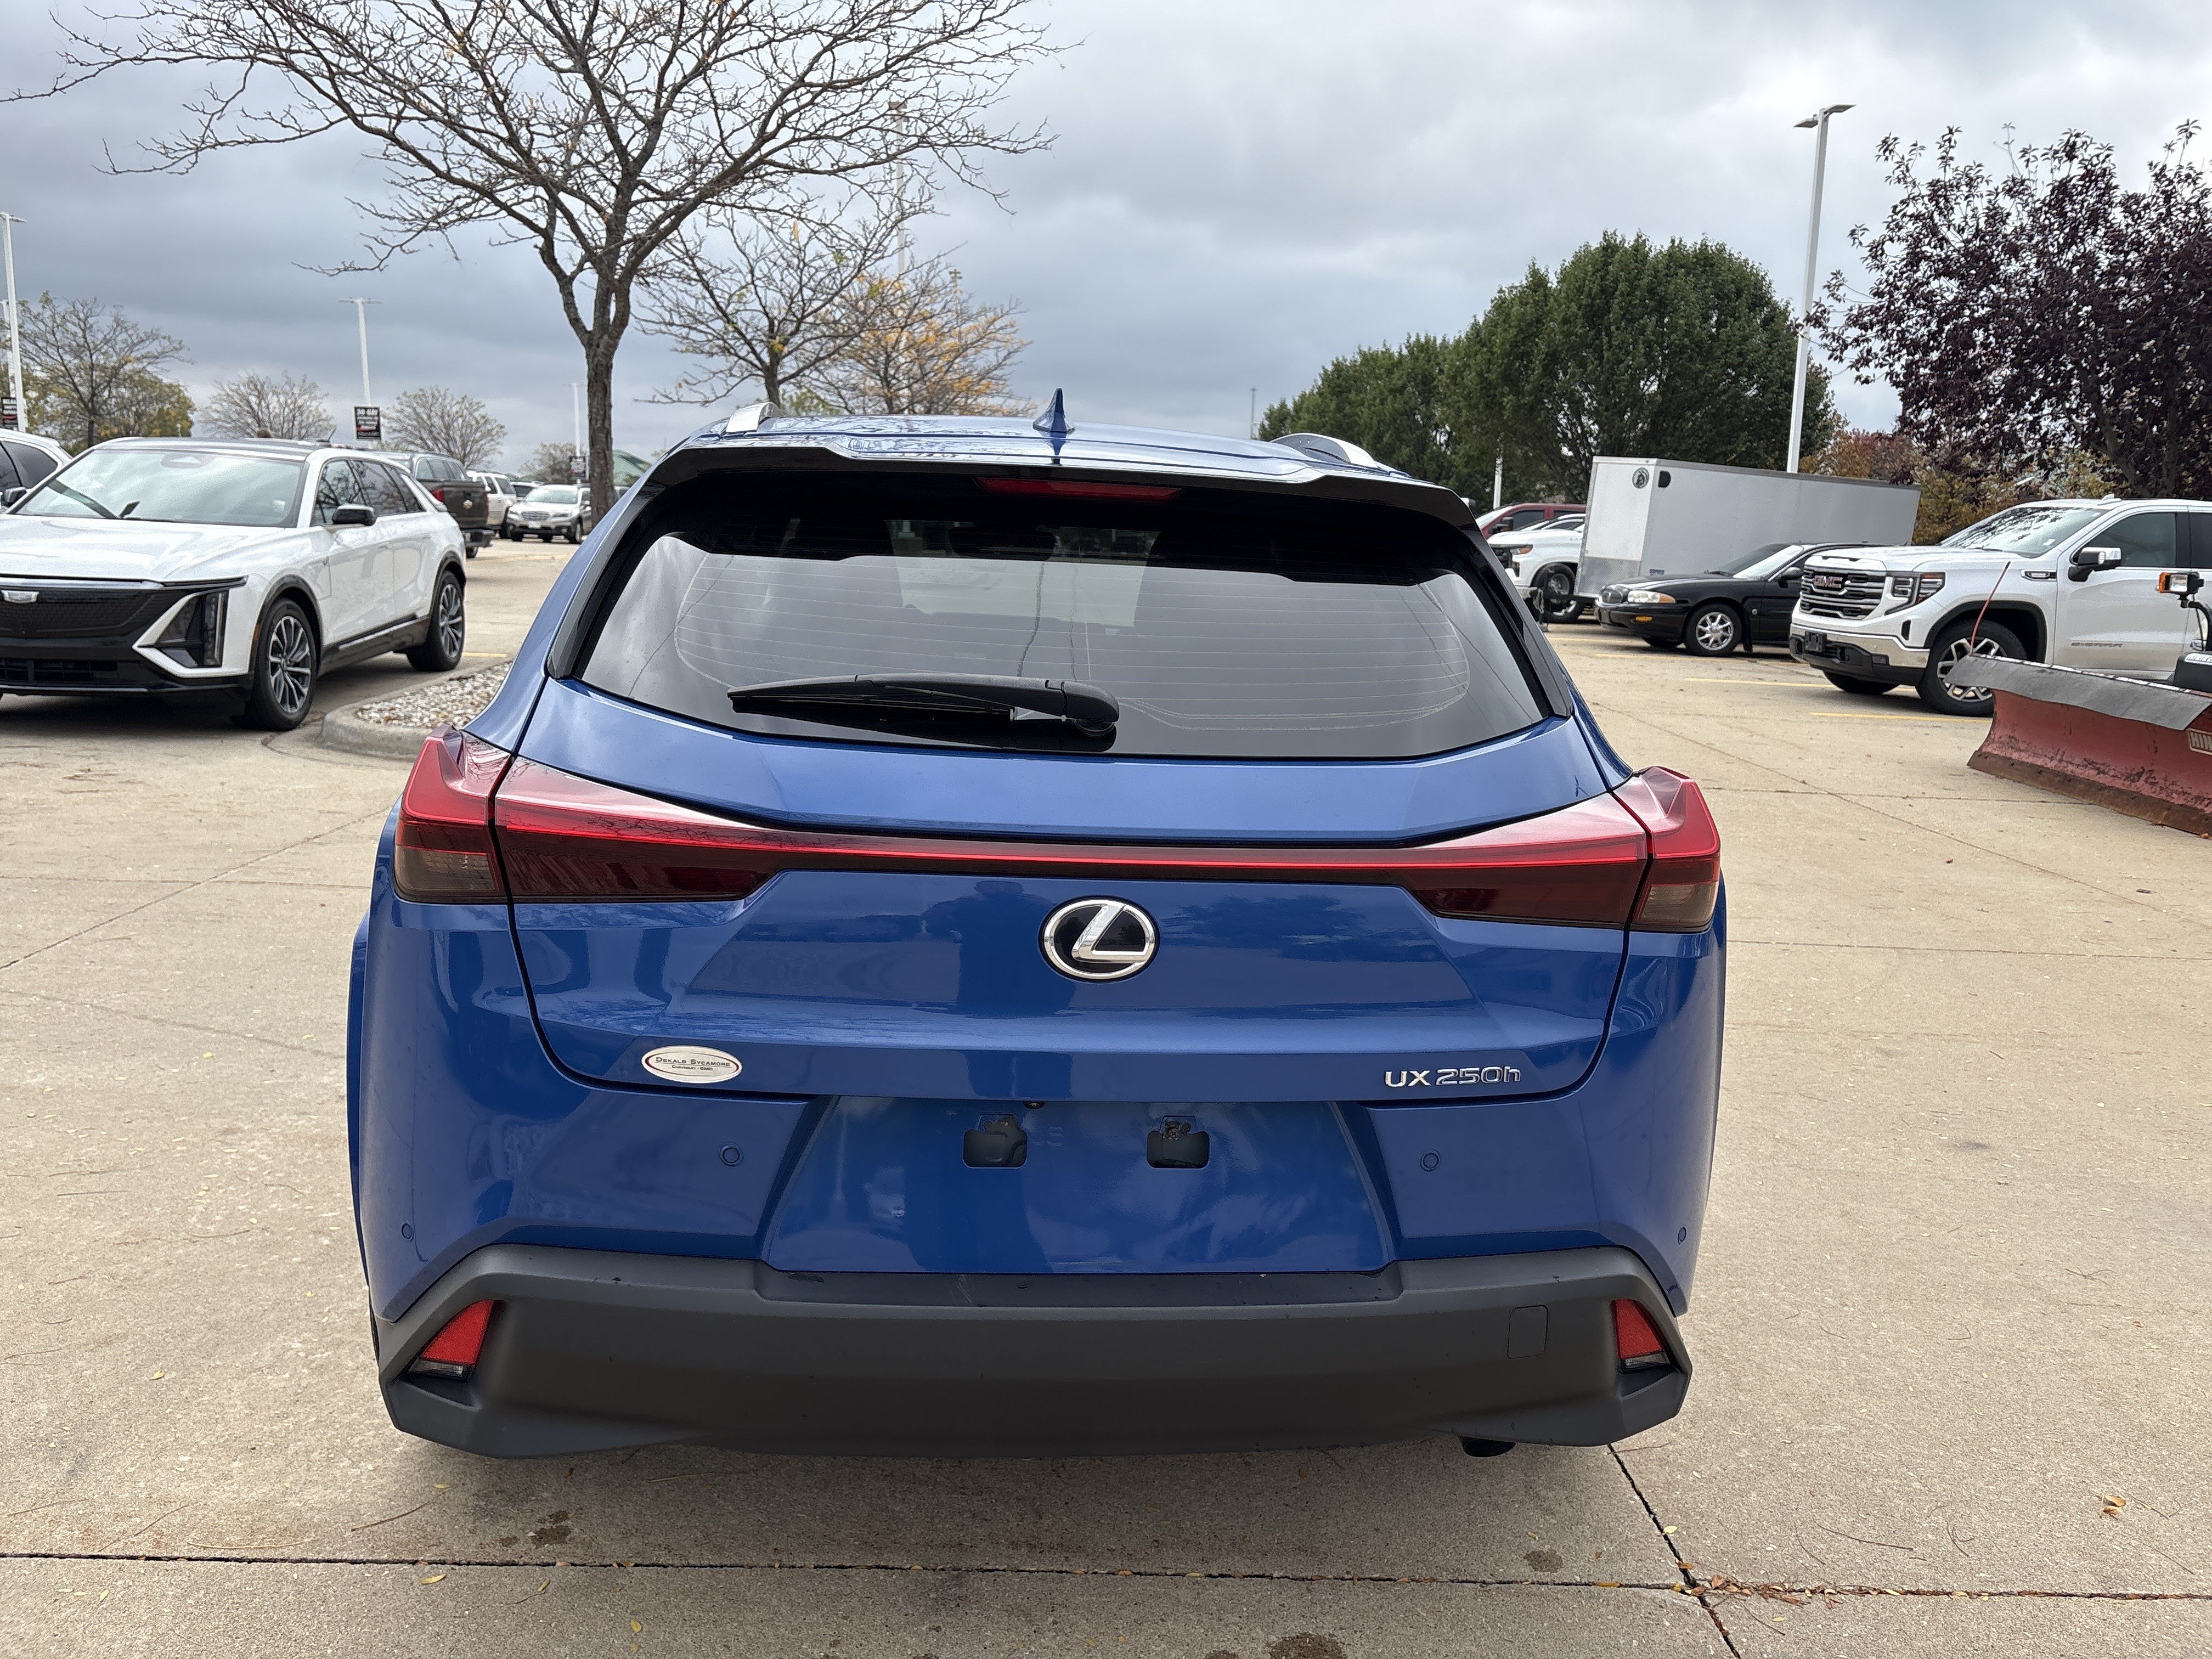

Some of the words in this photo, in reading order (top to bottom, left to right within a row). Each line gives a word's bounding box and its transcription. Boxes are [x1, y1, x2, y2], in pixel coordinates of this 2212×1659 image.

[1813, 575, 1843, 589] GMC
[1385, 1070, 1431, 1087] UX
[1436, 1066, 1521, 1086] 250h
